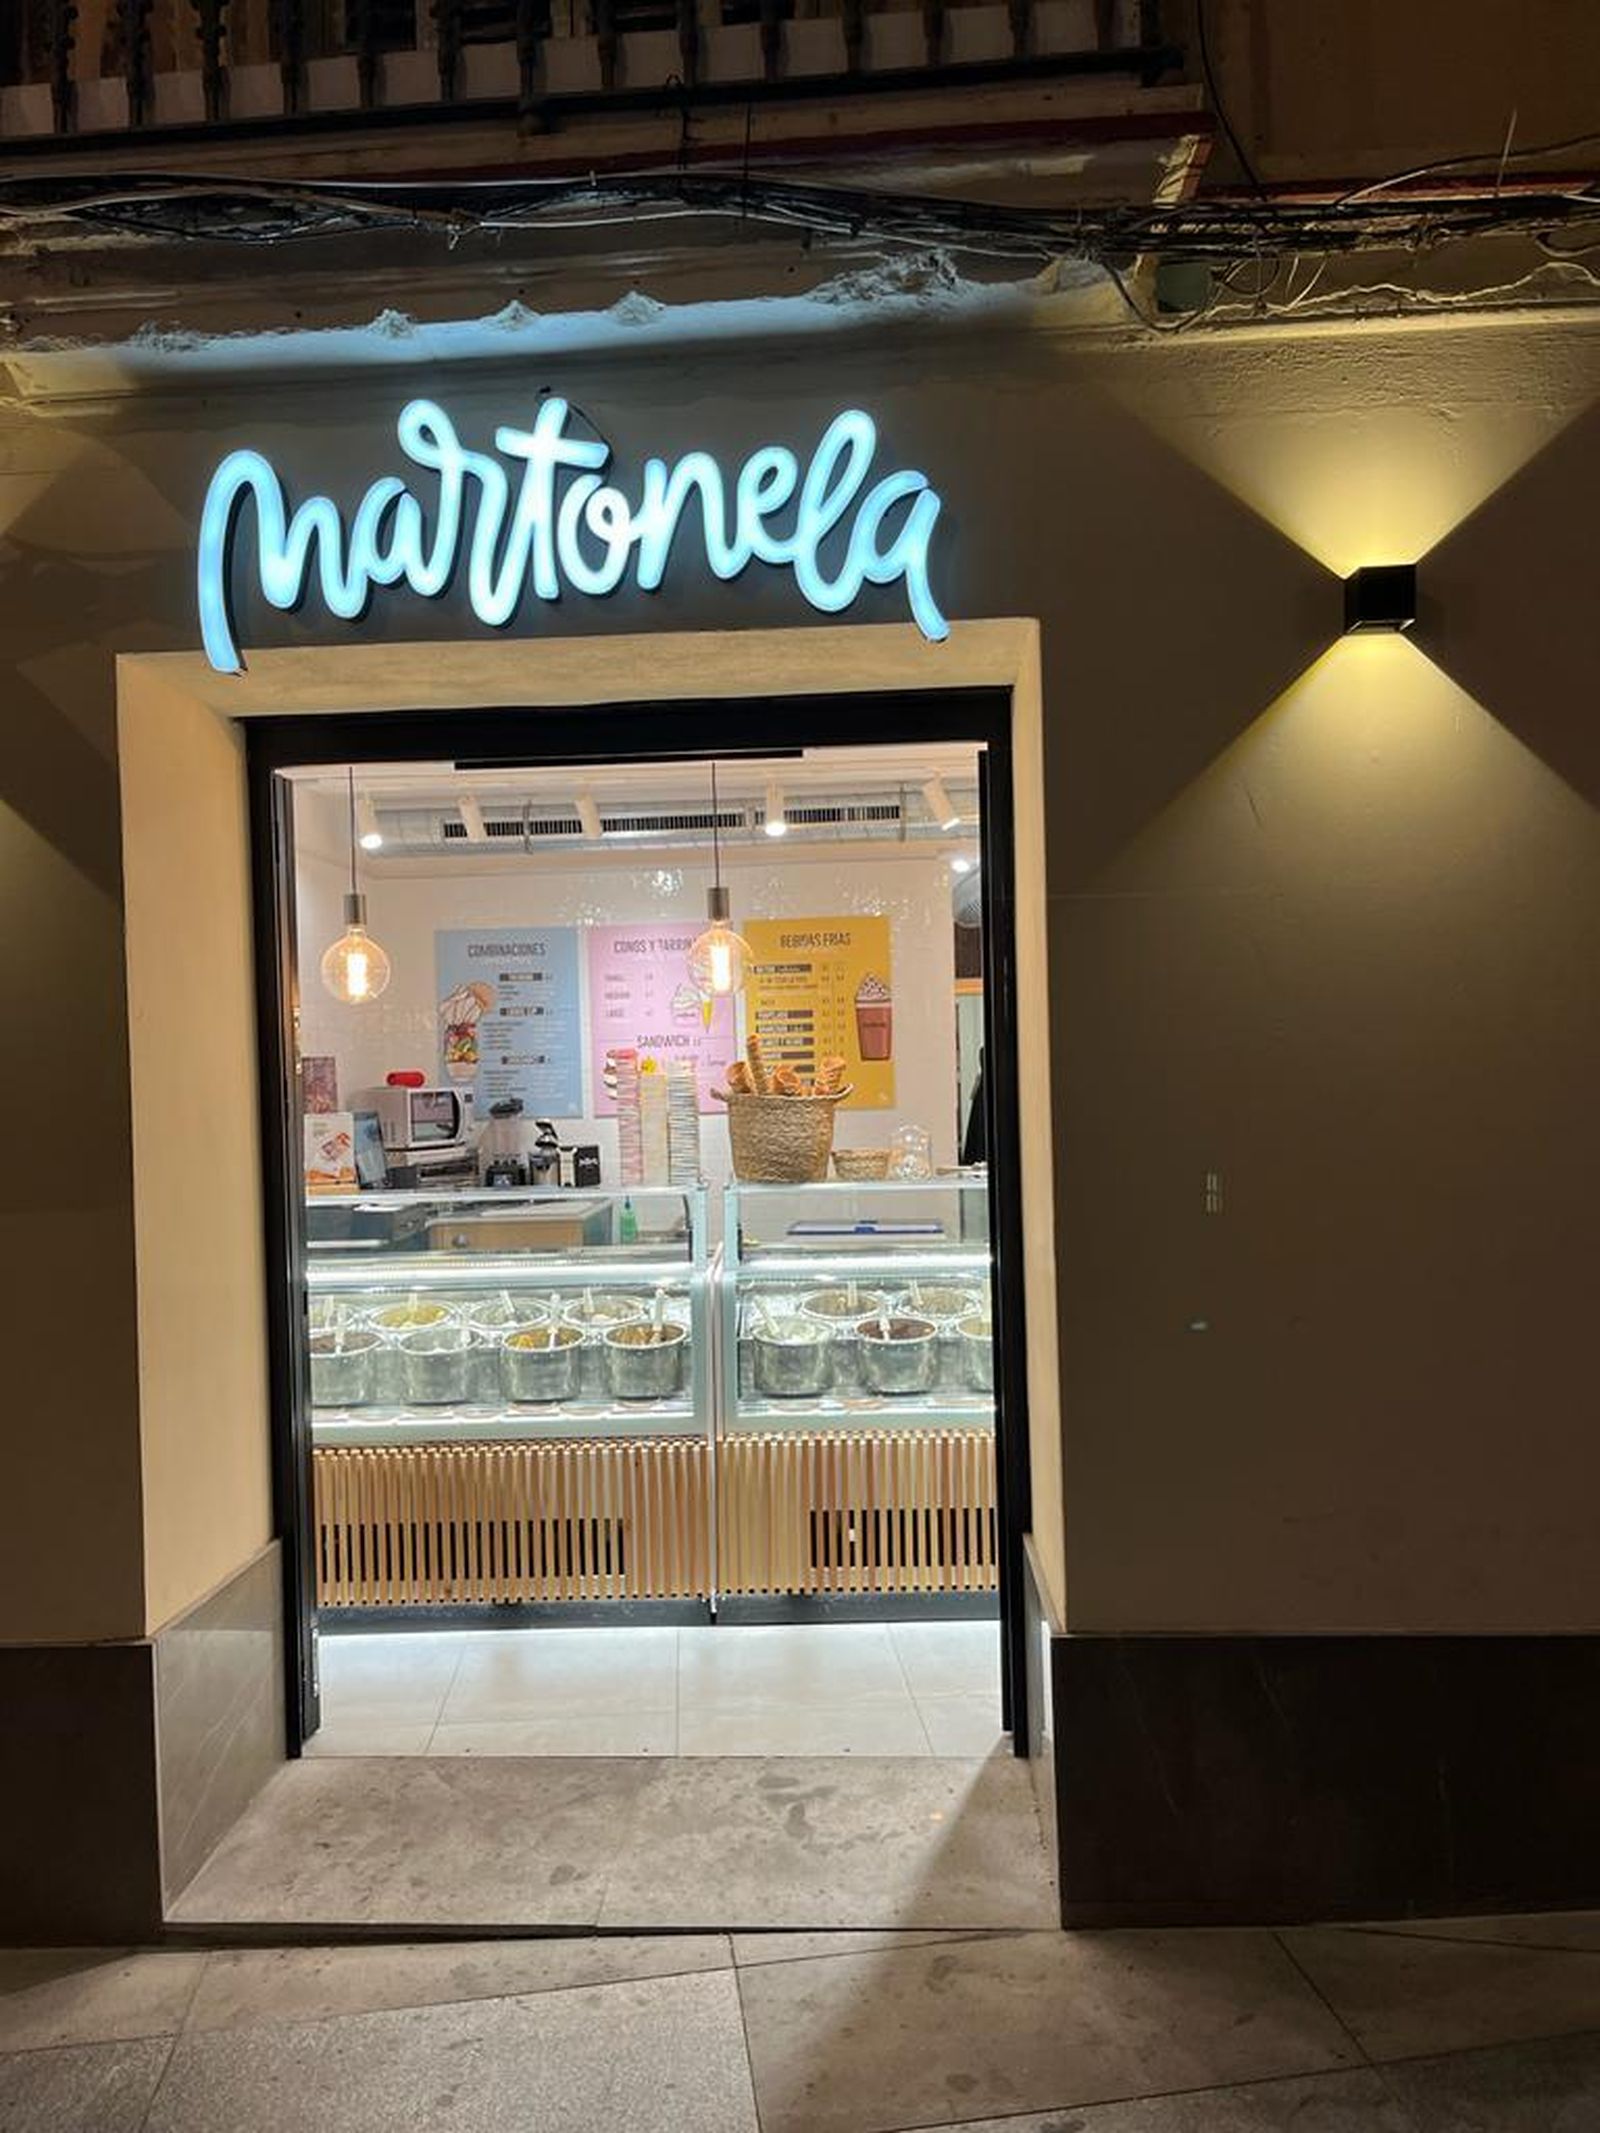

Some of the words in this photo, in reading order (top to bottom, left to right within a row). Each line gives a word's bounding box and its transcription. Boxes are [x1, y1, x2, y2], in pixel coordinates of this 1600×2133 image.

[614, 940, 647, 953] CONOS
[781, 933, 821, 948] BEBIDAS
[468, 943, 546, 958] COMBINACIONES
[637, 1034, 690, 1048] SANDWICH
